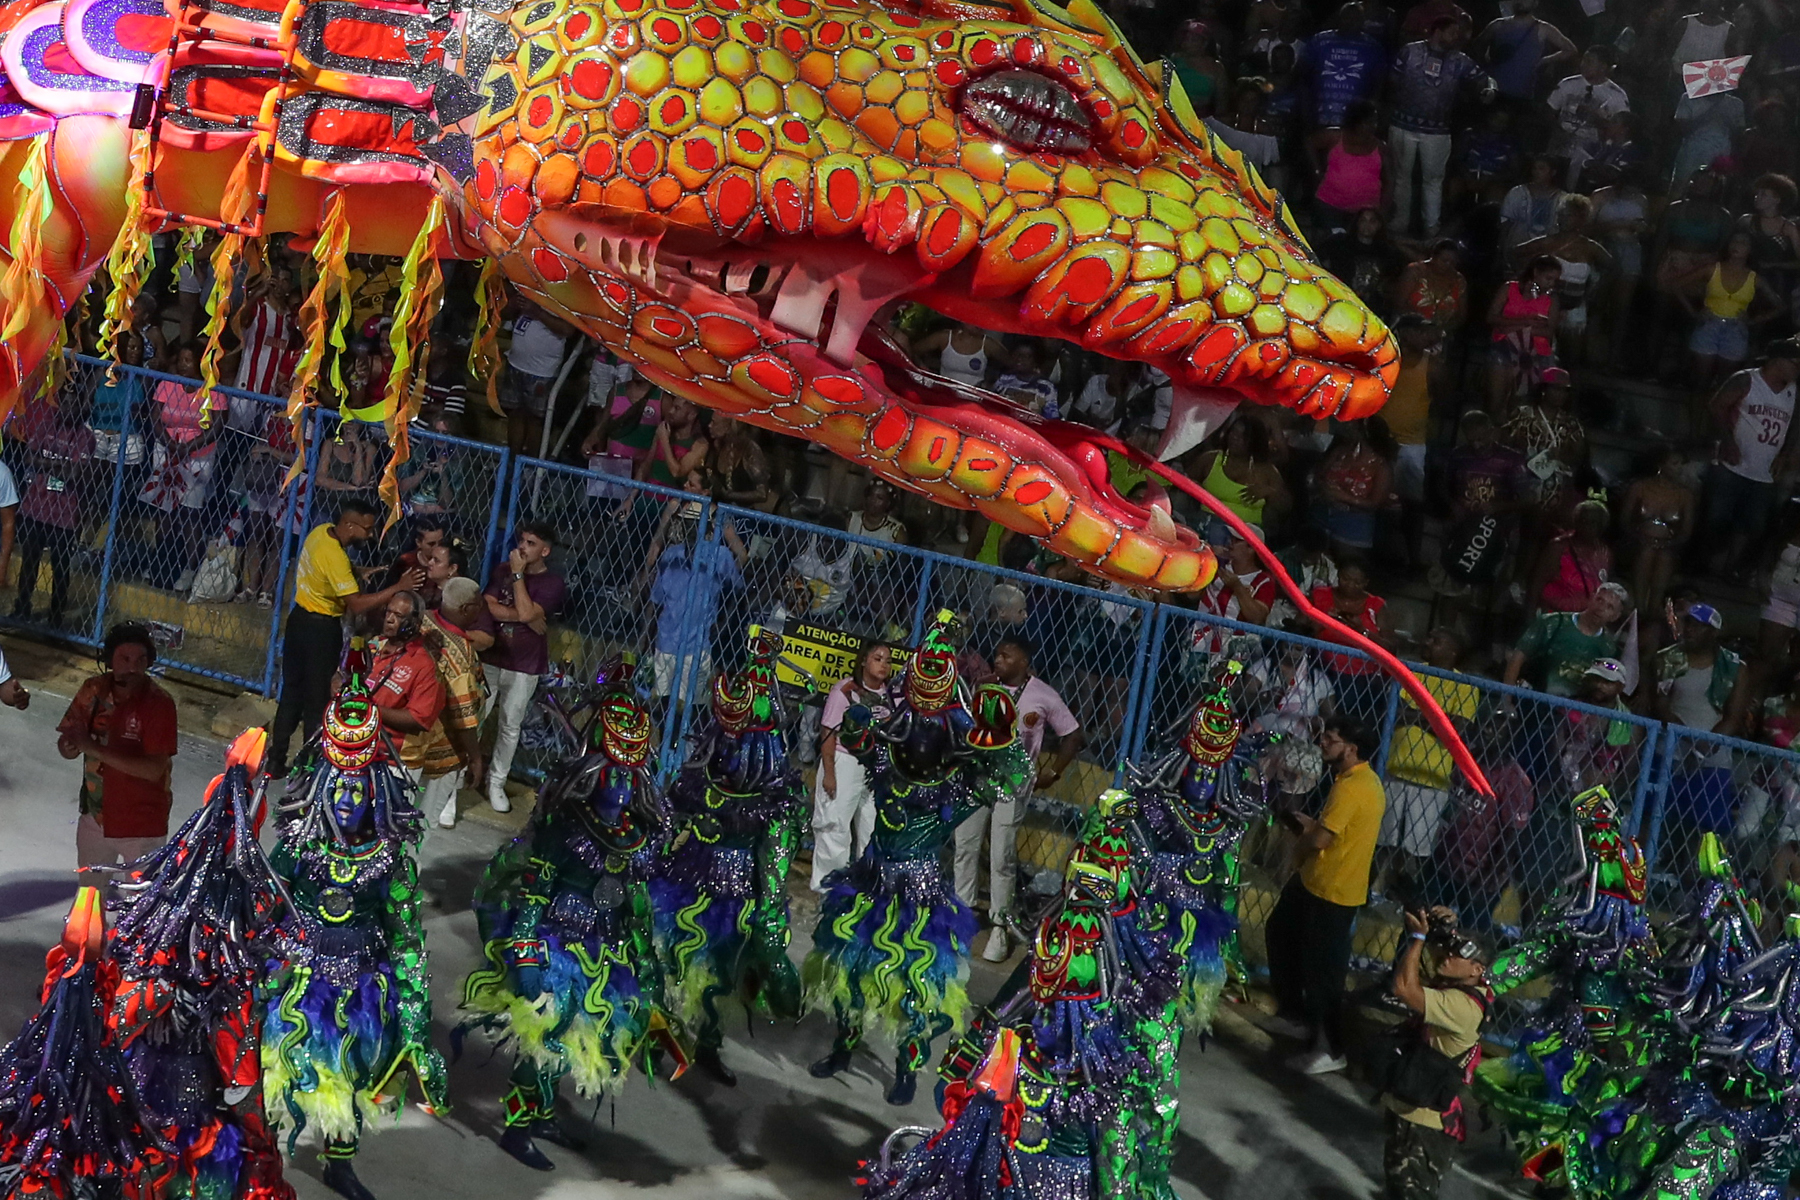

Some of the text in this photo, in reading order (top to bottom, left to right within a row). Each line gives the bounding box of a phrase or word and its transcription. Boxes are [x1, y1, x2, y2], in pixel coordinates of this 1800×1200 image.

[1758, 418, 1781, 447] 32
[1458, 515, 1497, 573] SPORT
[796, 624, 861, 650] ATENÇÃO!
[783, 640, 821, 661] ÁREA
[825, 652, 845, 668] DE
